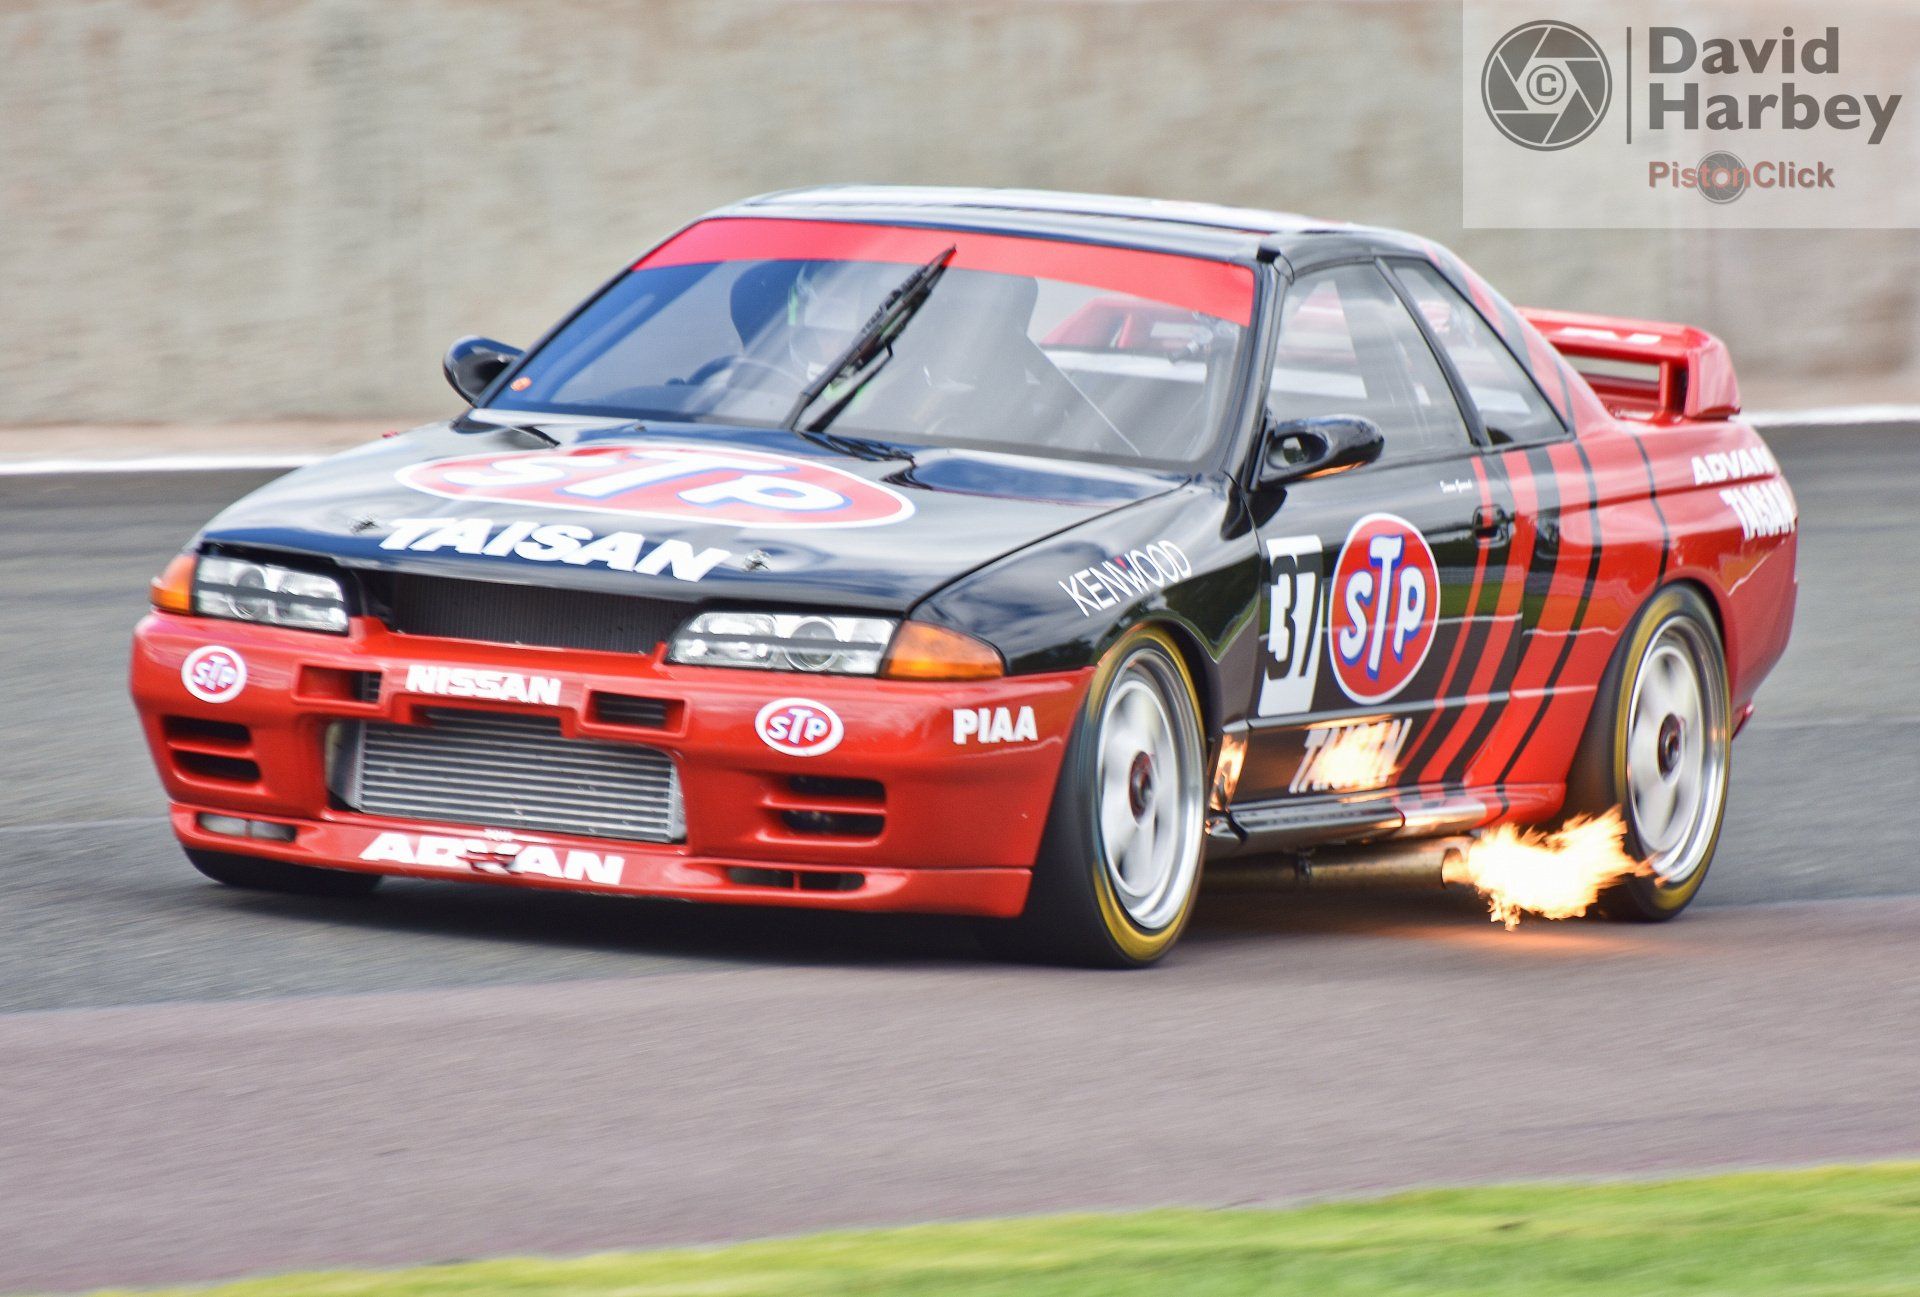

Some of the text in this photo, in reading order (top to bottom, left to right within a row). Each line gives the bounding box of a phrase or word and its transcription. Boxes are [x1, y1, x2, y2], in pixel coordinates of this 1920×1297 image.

[443, 451, 853, 511] STP
[1691, 447, 1775, 486] ADVAN
[379, 518, 731, 583] TAISAN
[1058, 540, 1192, 617] KENWOOD
[1338, 534, 1427, 682] STP
[405, 664, 562, 706] NISSAN
[766, 708, 828, 745] STP
[953, 705, 1038, 745] PIAA
